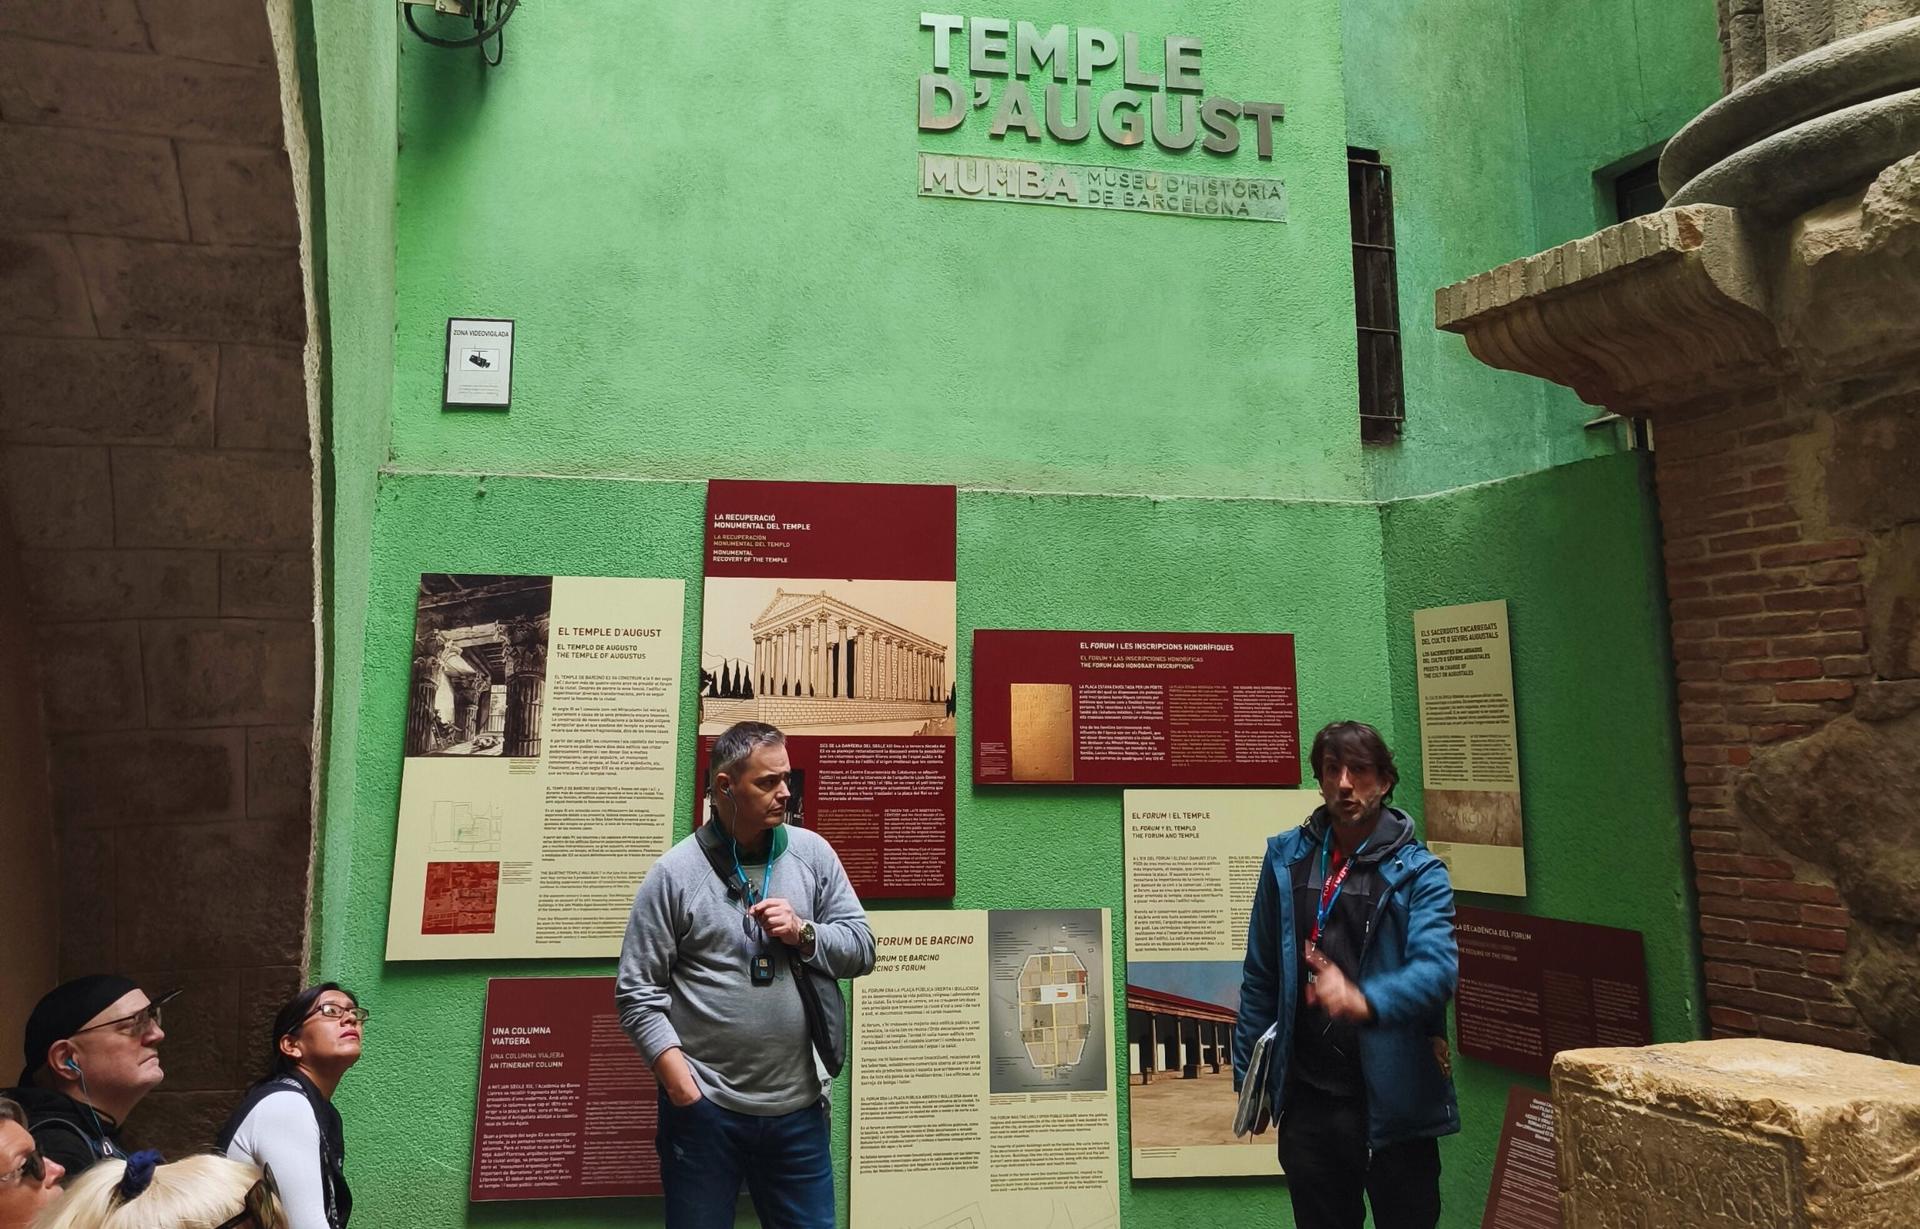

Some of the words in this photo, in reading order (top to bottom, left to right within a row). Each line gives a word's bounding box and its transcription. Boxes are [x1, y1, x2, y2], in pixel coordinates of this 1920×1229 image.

[920, 12, 1203, 91] TEMPLE
[918, 74, 1285, 159] D'AUGUST
[923, 157, 1078, 201] MUMBA
[1087, 171, 1158, 192] MUSEU
[1088, 190, 1114, 206] DE
[1123, 192, 1250, 216] BARCELONA
[725, 513, 776, 522] RECUPERACIÓ
[714, 522, 765, 530] MONUMENTAL
[558, 627, 570, 636] EL
[572, 628, 611, 636] TEMPLE
[614, 628, 662, 638] D'AUGUST
[877, 937, 912, 946] FORUM
[915, 937, 928, 945] DE
[930, 936, 974, 945] BARCINO
[1499, 930, 1510, 938] DEL
[1511, 931, 1532, 940] FORUM
